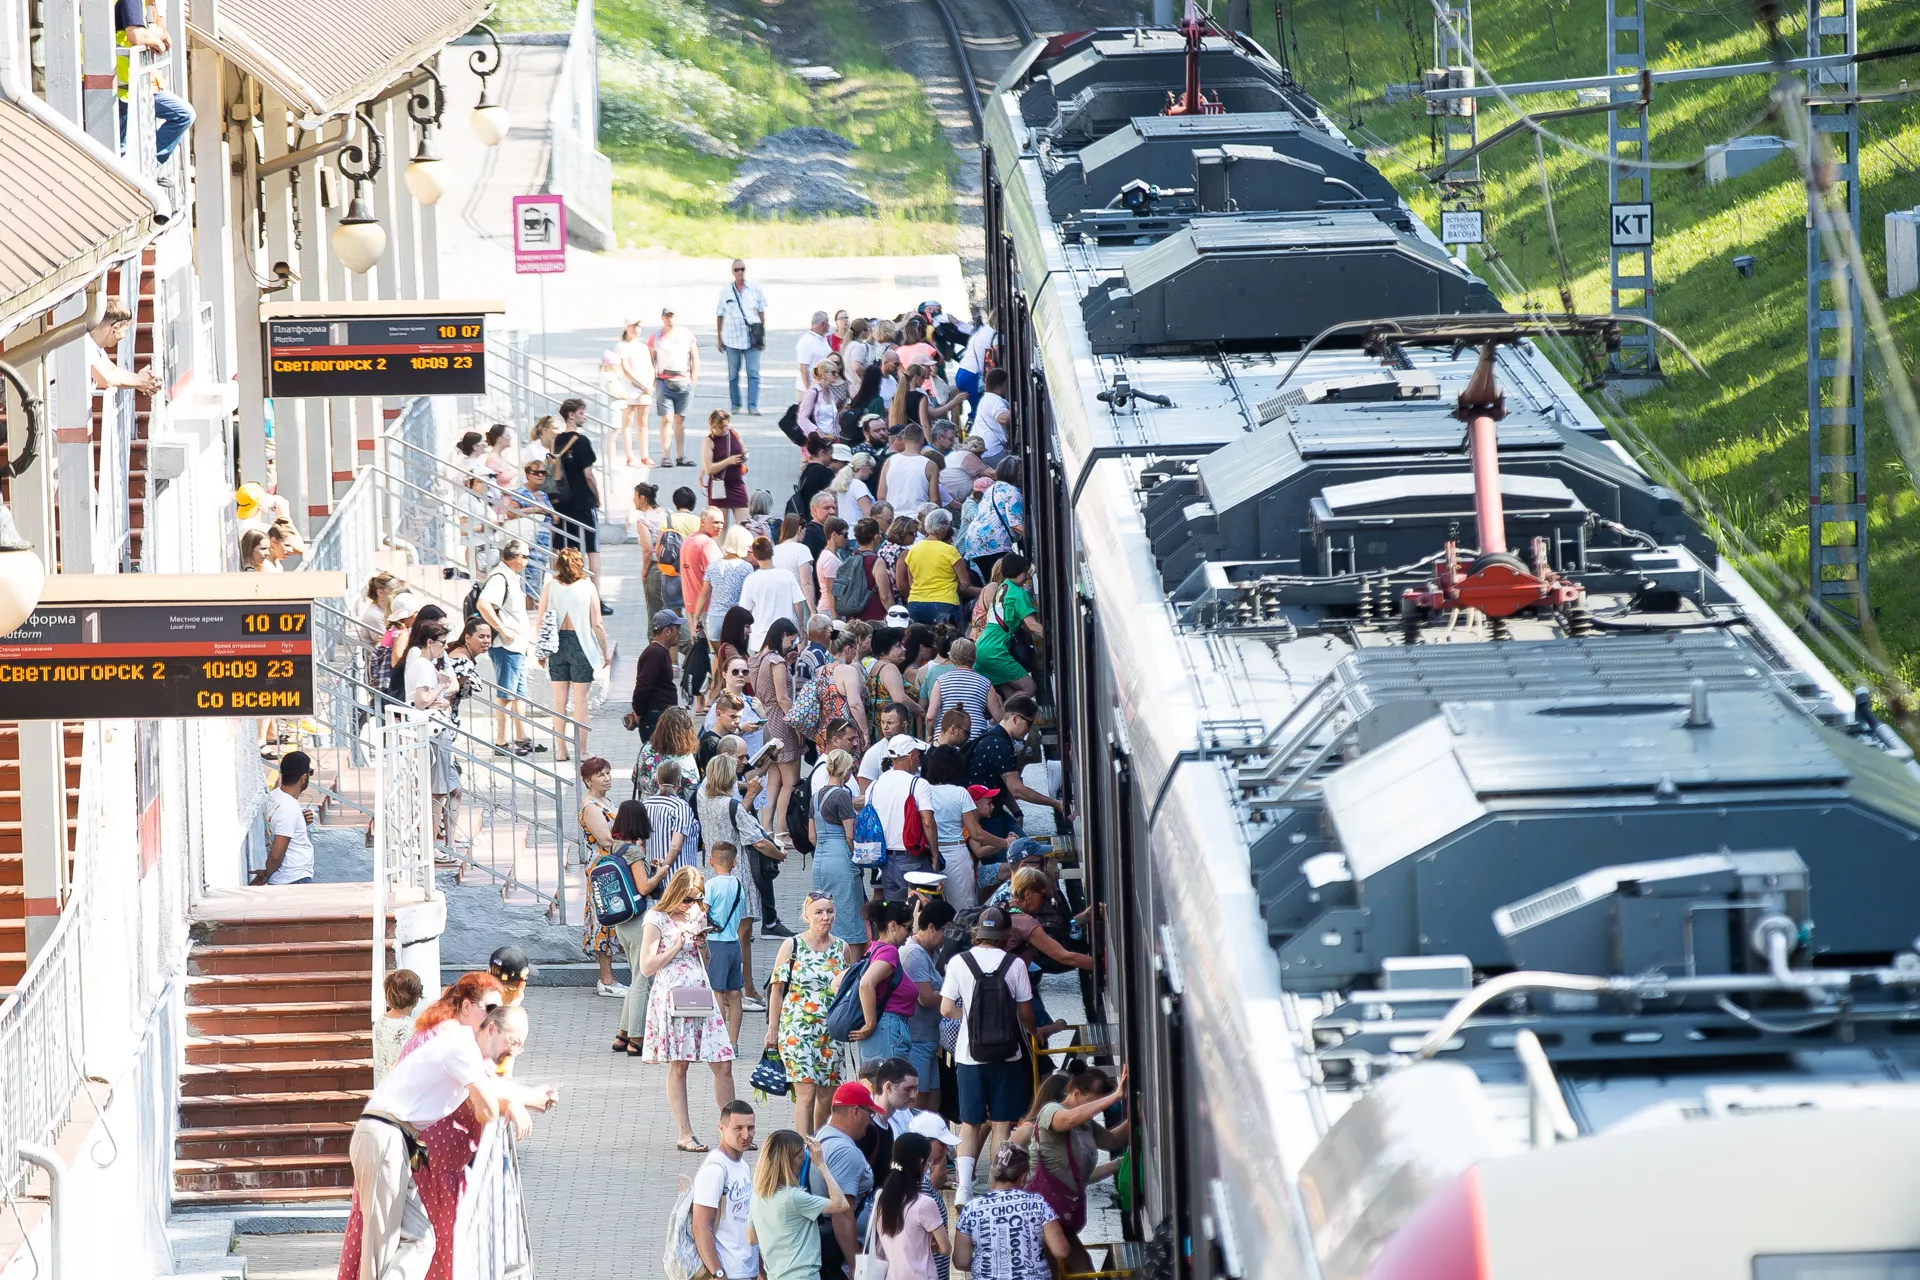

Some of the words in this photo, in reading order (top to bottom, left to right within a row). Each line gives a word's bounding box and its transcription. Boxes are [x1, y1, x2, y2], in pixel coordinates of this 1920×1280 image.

[1615, 214, 1649, 235] КТ
[273, 325, 327, 335] Платформа
[329, 323, 340, 345] 1
[438, 326, 457, 338] 10
[461, 325, 481, 338] 07
[376, 358, 388, 370] 2
[410, 357, 448, 369] 10:09
[453, 356, 473, 369] 23
[84, 612, 98, 644] 1
[201, 616, 224, 624] время
[245, 613, 270, 632] 10
[279, 613, 306, 632] 07
[152, 661, 166, 680] 2
[202, 660, 258, 679] 10:09
[267, 659, 294, 678] 23
[197, 690, 224, 708] Со
[980, 1216, 993, 1279] HOCOLATE
